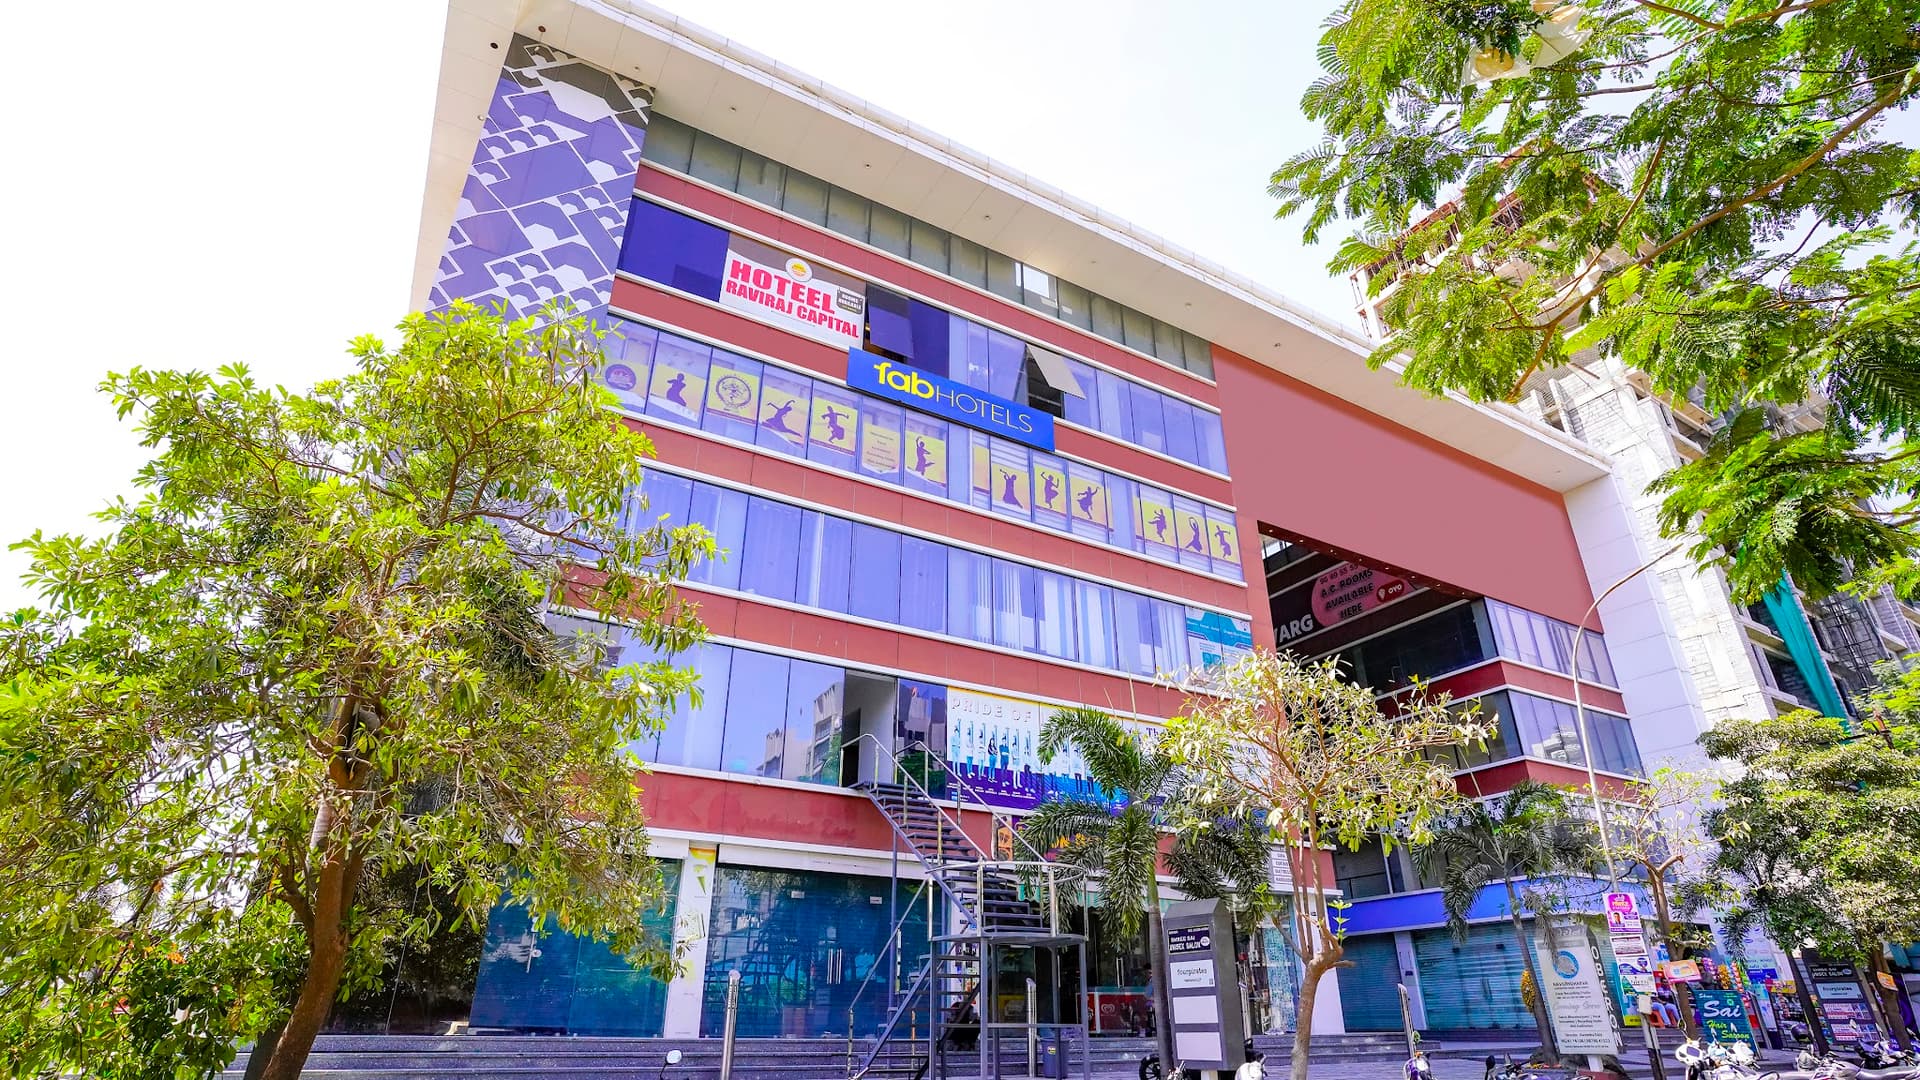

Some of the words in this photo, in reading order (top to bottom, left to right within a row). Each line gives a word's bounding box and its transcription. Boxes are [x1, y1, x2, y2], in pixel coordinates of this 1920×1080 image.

[730, 259, 835, 314] HOTEEL
[725, 279, 793, 315] RAVIRAJ
[796, 305, 860, 339] CAPITAL
[1339, 568, 1374, 589] ROOMS
[1387, 583, 1403, 594] OYO
[1325, 582, 1375, 610] AVAILABLE
[1339, 602, 1363, 618] HERE
[1274, 614, 1314, 643] ARG
[951, 697, 1003, 718] PRIDE
[1012, 709, 1032, 723] OF
[1703, 1000, 1741, 1017] Sai
